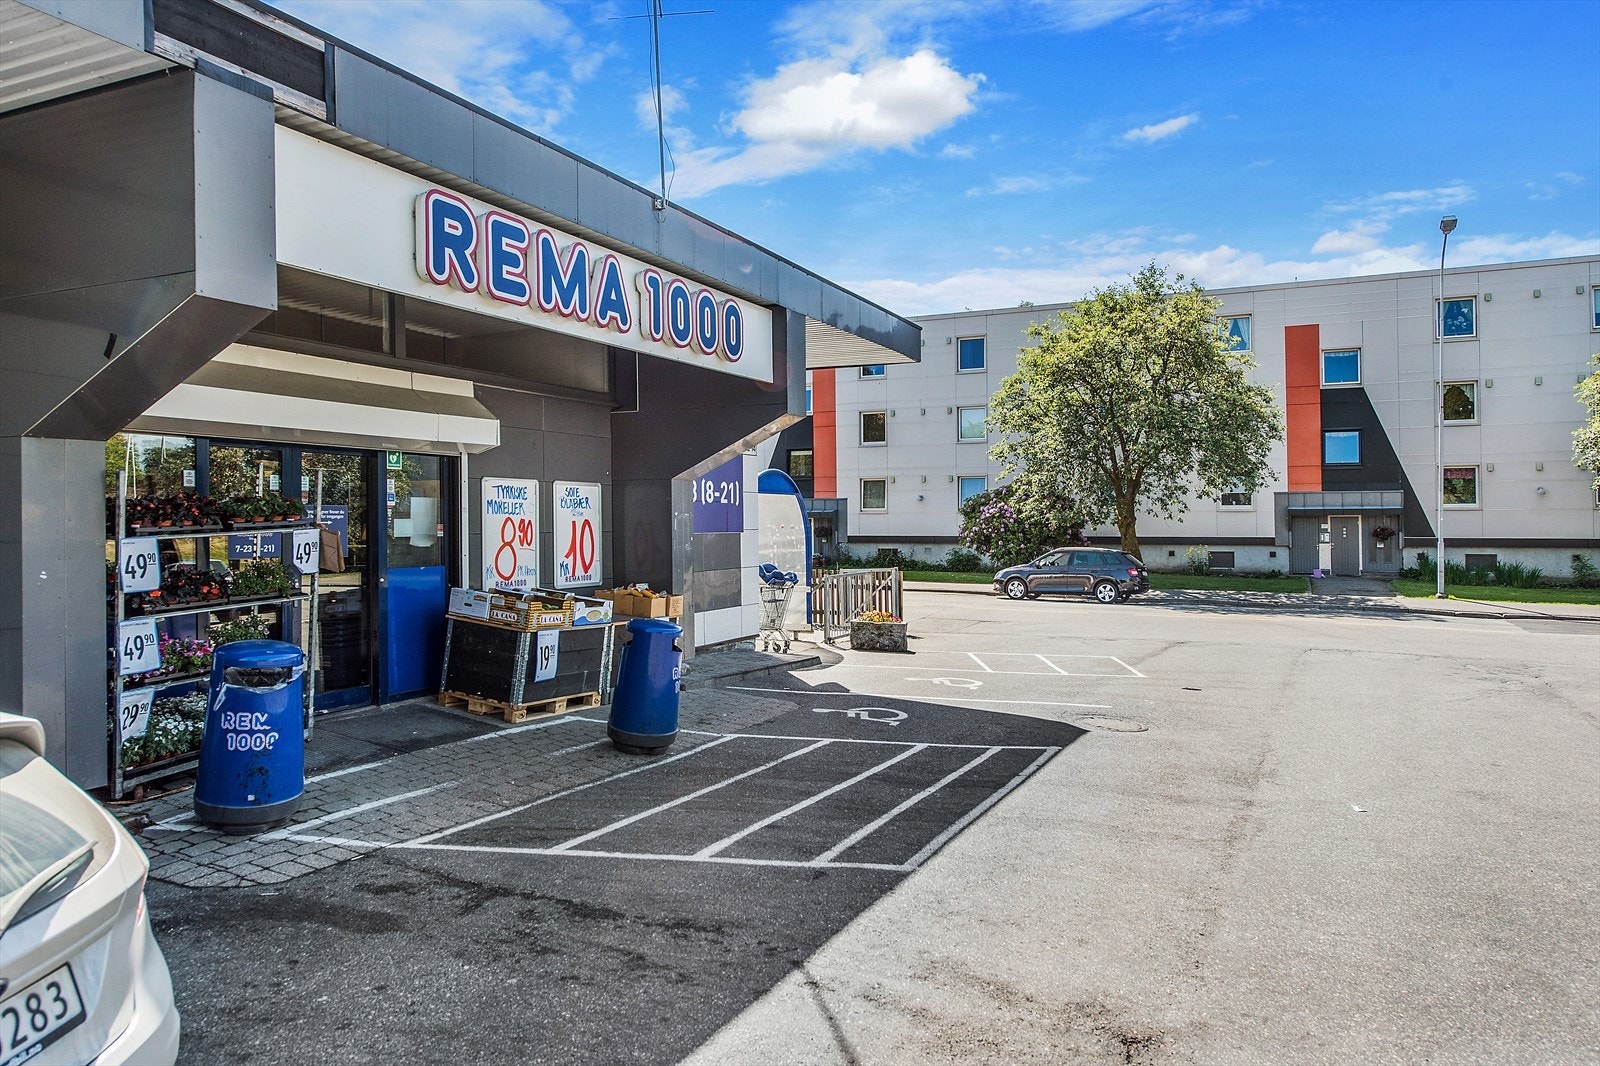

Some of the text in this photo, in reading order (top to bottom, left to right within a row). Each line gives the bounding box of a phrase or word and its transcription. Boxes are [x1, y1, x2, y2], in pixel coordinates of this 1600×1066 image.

[418, 189, 744, 362] REMA 1000
[491, 484, 528, 501] TYRKISKE
[701, 478, 740, 506] (8-21)
[235, 544, 253, 553] 7-23
[495, 516, 517, 581] 8
[564, 519, 595, 578] 10
[221, 711, 271, 730] REM
[0, 981, 68, 1056] 283
